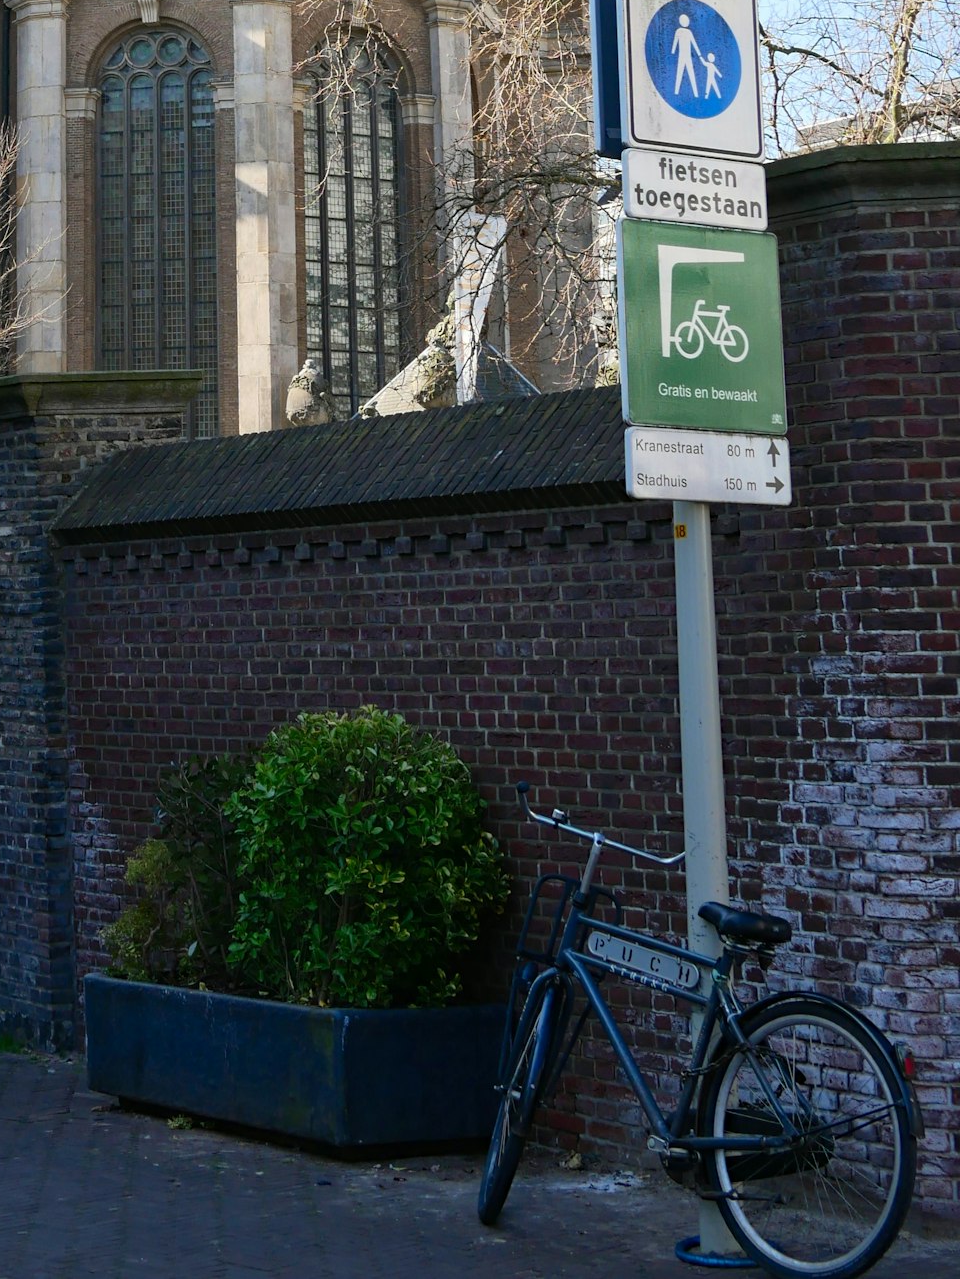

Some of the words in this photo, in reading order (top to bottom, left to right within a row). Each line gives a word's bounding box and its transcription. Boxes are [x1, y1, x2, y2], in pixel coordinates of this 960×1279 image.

[658, 156, 737, 188] fietsen
[634, 183, 763, 219] toegestaan
[658, 382, 691, 398] Gratis
[694, 388, 709, 399] en
[711, 386, 758, 403] bewaakt
[635, 438, 704, 455] Kranestraat
[727, 444, 741, 458] 80
[745, 449, 755, 458] m
[636, 472, 688, 489] Stadhuis
[724, 477, 743, 491] 150
[747, 482, 757, 491] m
[594, 937, 691, 983] PUCH
